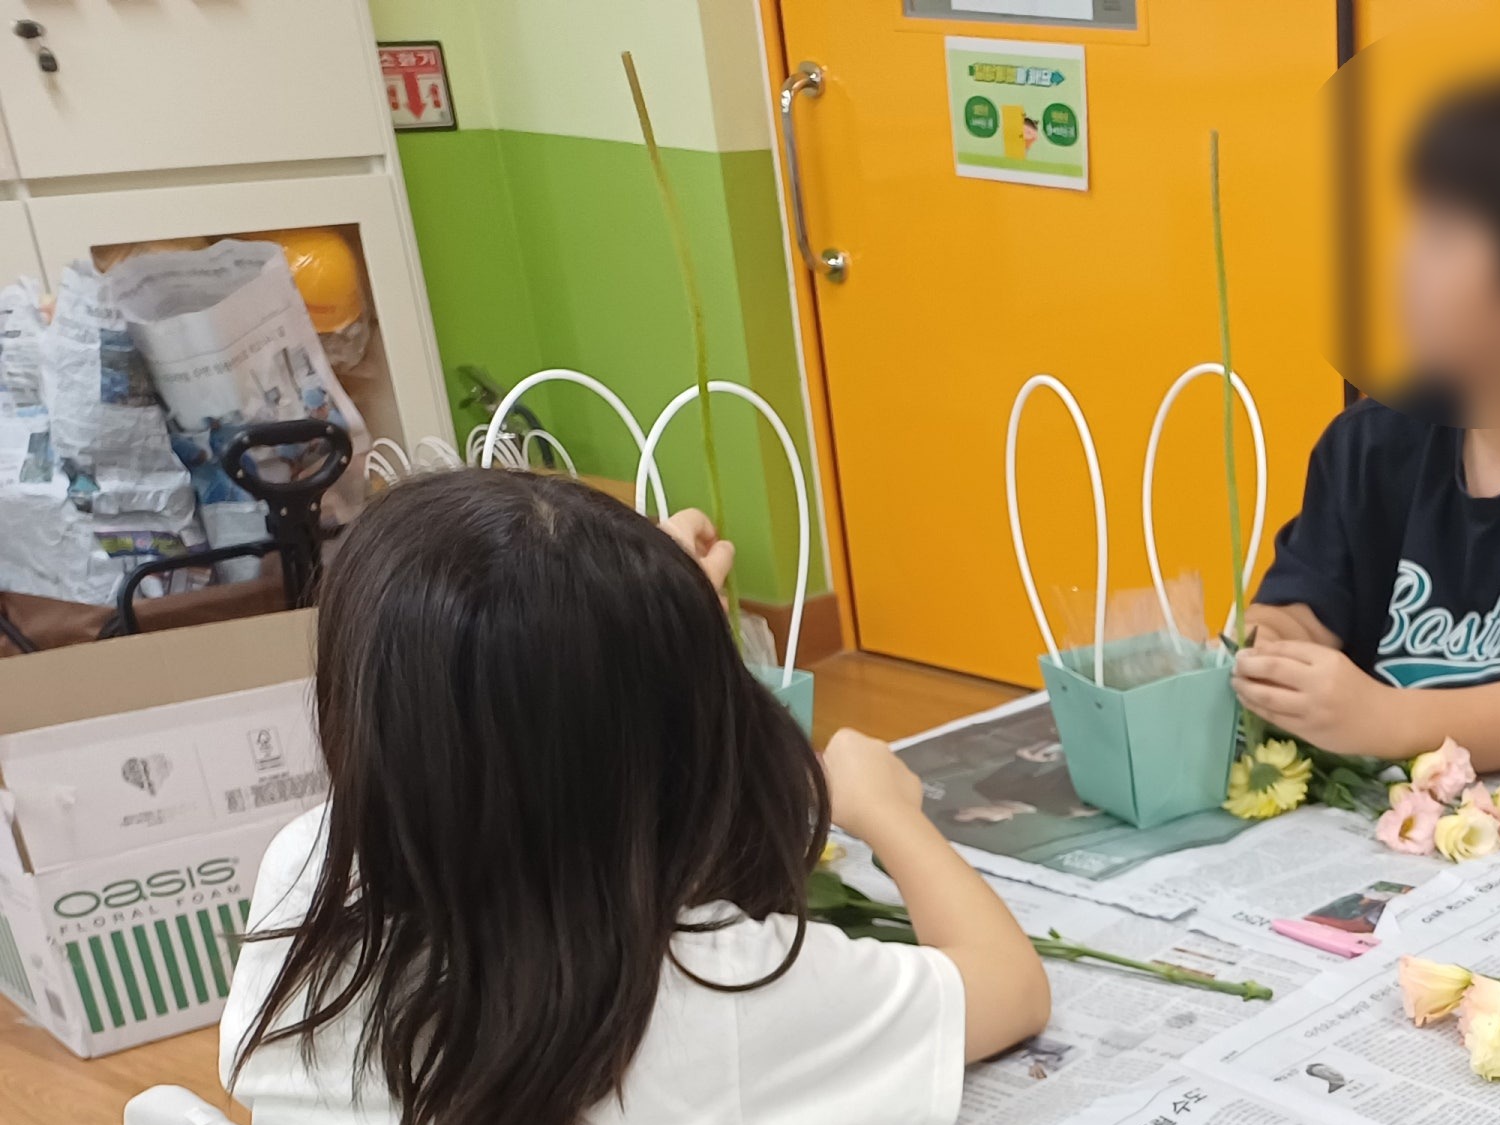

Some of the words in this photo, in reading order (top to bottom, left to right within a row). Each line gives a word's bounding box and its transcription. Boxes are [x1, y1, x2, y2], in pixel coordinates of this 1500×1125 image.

[381, 51, 436, 67] 소화기
[59, 905, 160, 934] FLORAL
[176, 883, 243, 906] FOAM
